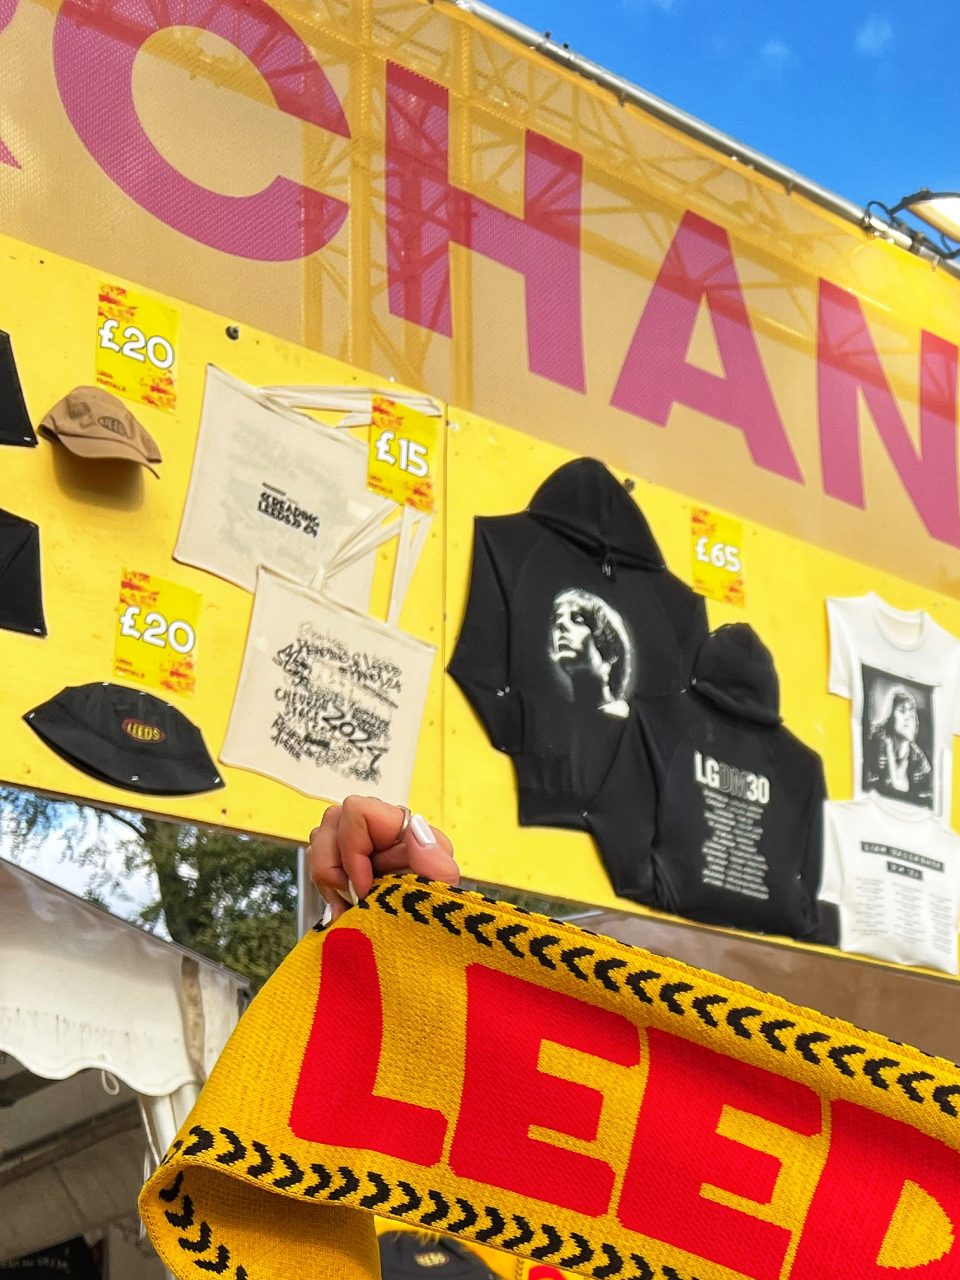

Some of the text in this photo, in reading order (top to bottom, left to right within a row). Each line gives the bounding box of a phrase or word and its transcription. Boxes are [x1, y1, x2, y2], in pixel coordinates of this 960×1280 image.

[98, 318, 176, 369] £20
[376, 430, 430, 478] £15
[695, 536, 742, 573] £65
[119, 605, 196, 654] £20
[126, 722, 161, 742] LEEDS
